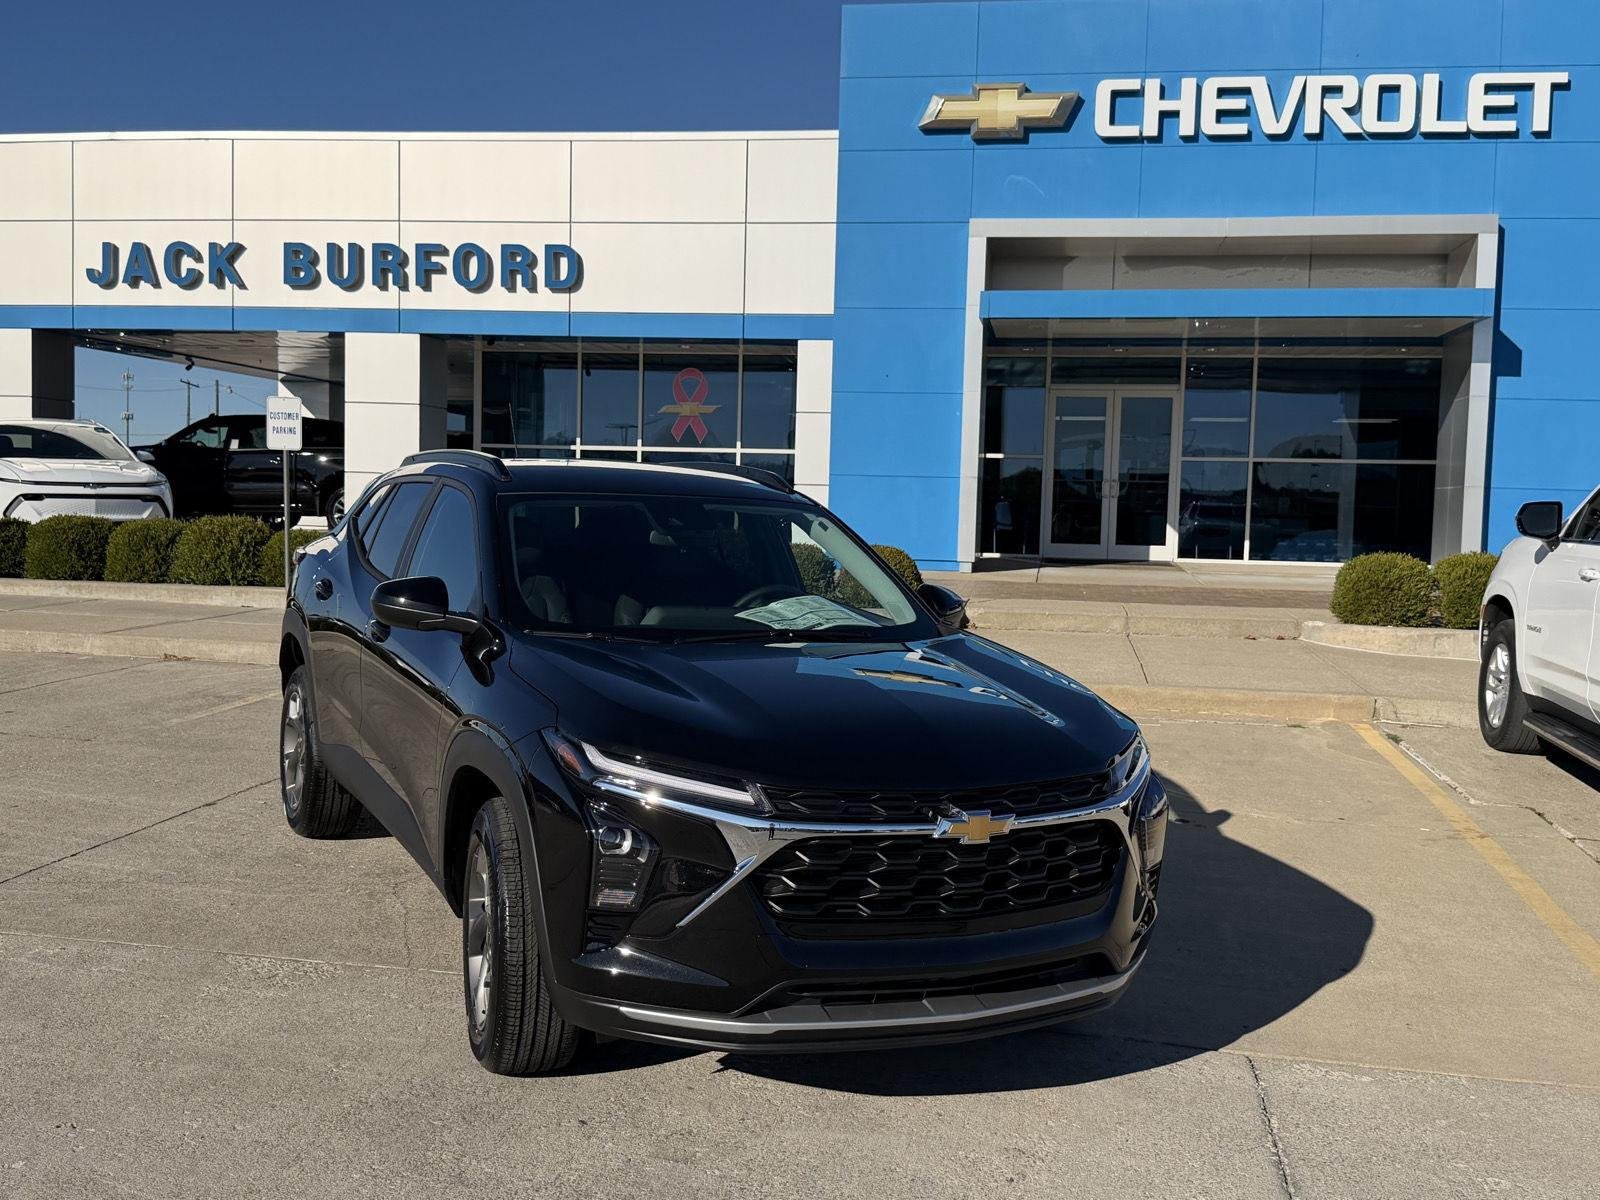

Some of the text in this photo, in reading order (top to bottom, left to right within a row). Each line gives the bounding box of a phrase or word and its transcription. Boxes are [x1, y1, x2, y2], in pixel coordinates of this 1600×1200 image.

[1094, 72, 1569, 138] CHEVROLET
[86, 240, 584, 293] JACK BURFORD
[269, 411, 299, 420] CUSTOMER
[272, 426, 296, 434] PARKING
